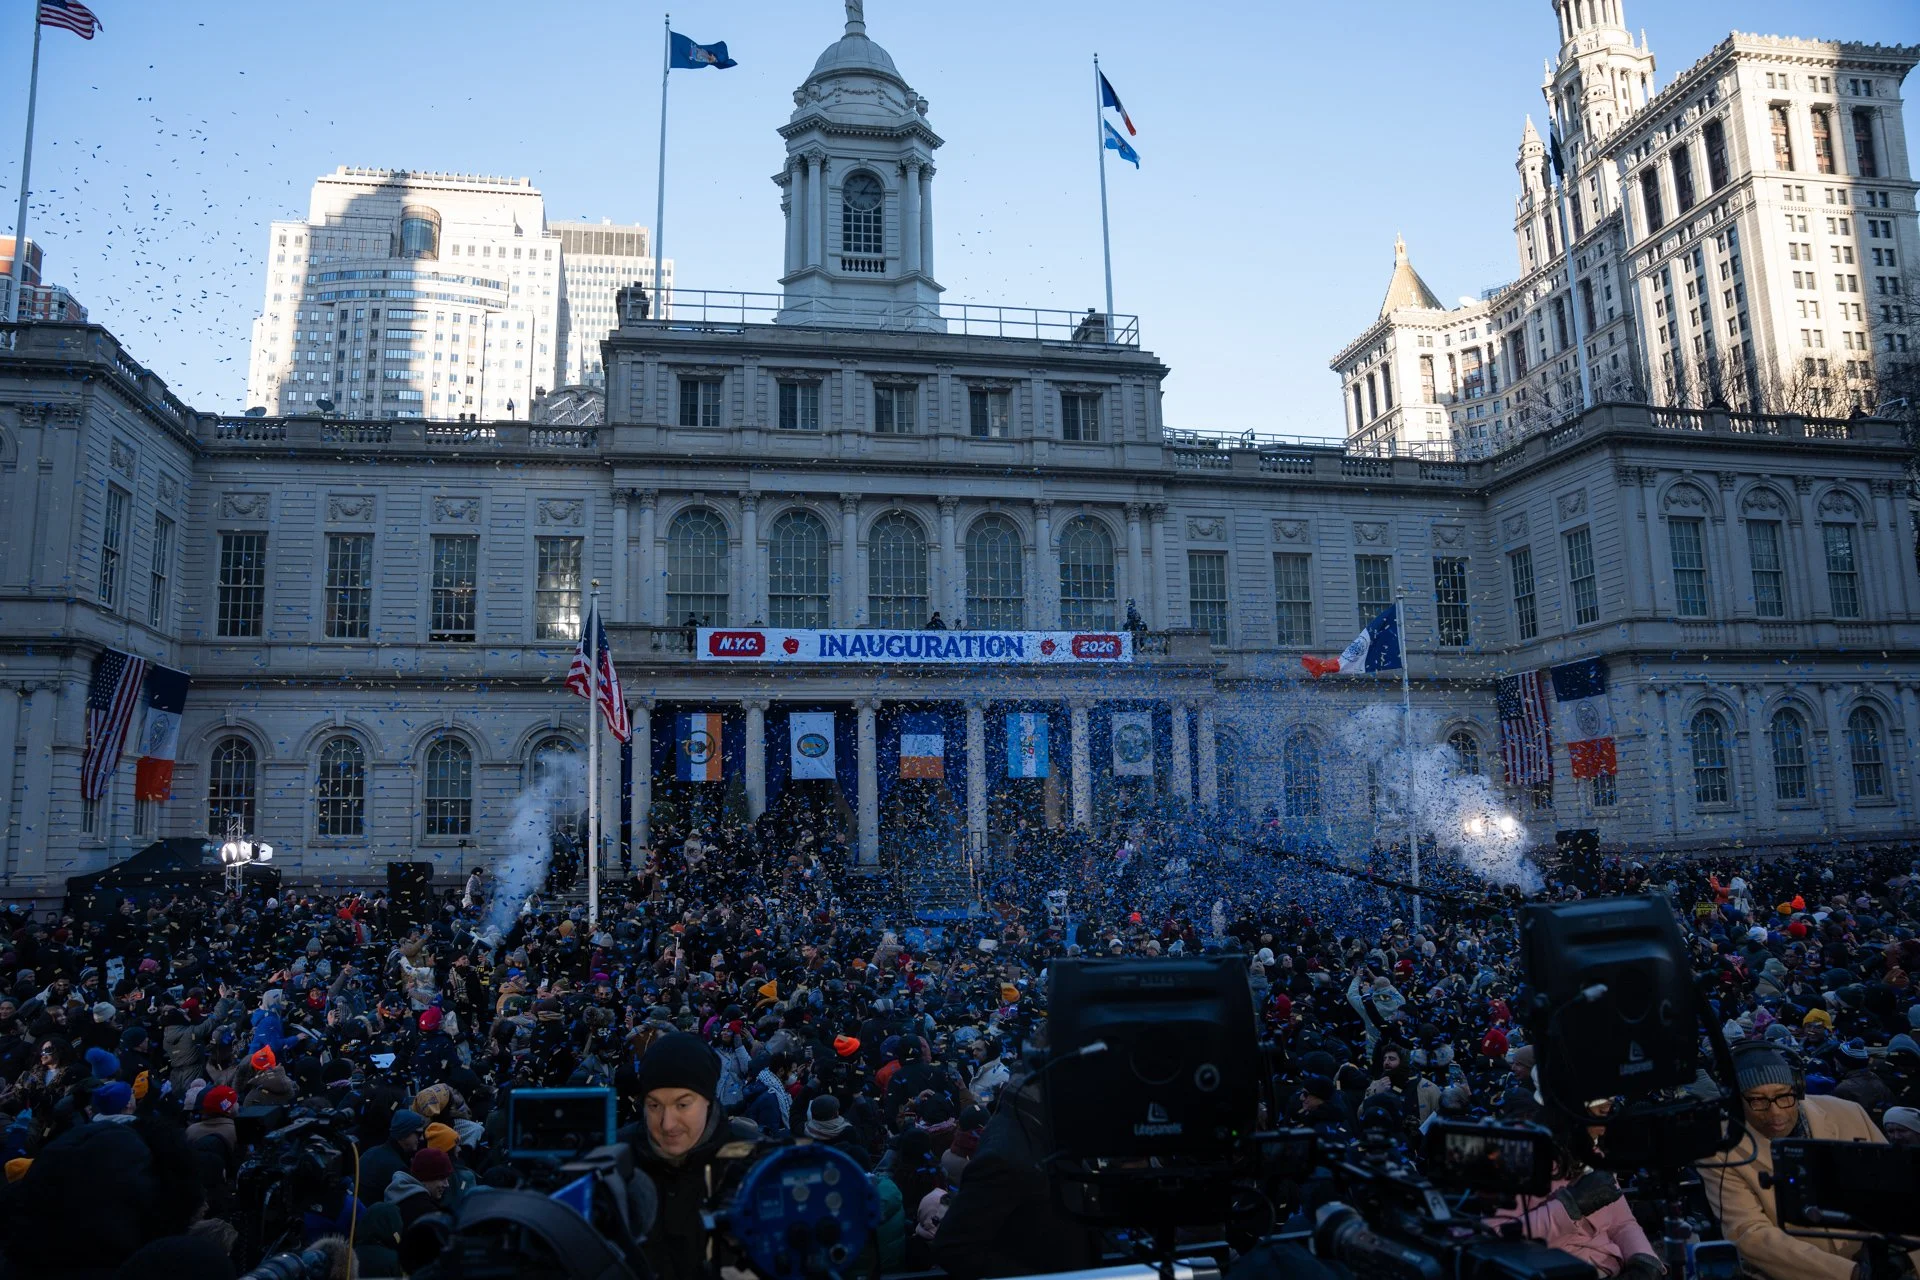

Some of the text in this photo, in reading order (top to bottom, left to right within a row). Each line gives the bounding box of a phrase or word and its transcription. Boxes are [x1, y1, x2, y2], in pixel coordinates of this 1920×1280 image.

[719, 634, 1115, 657] N.Y.C. INAUGURATION 2026
